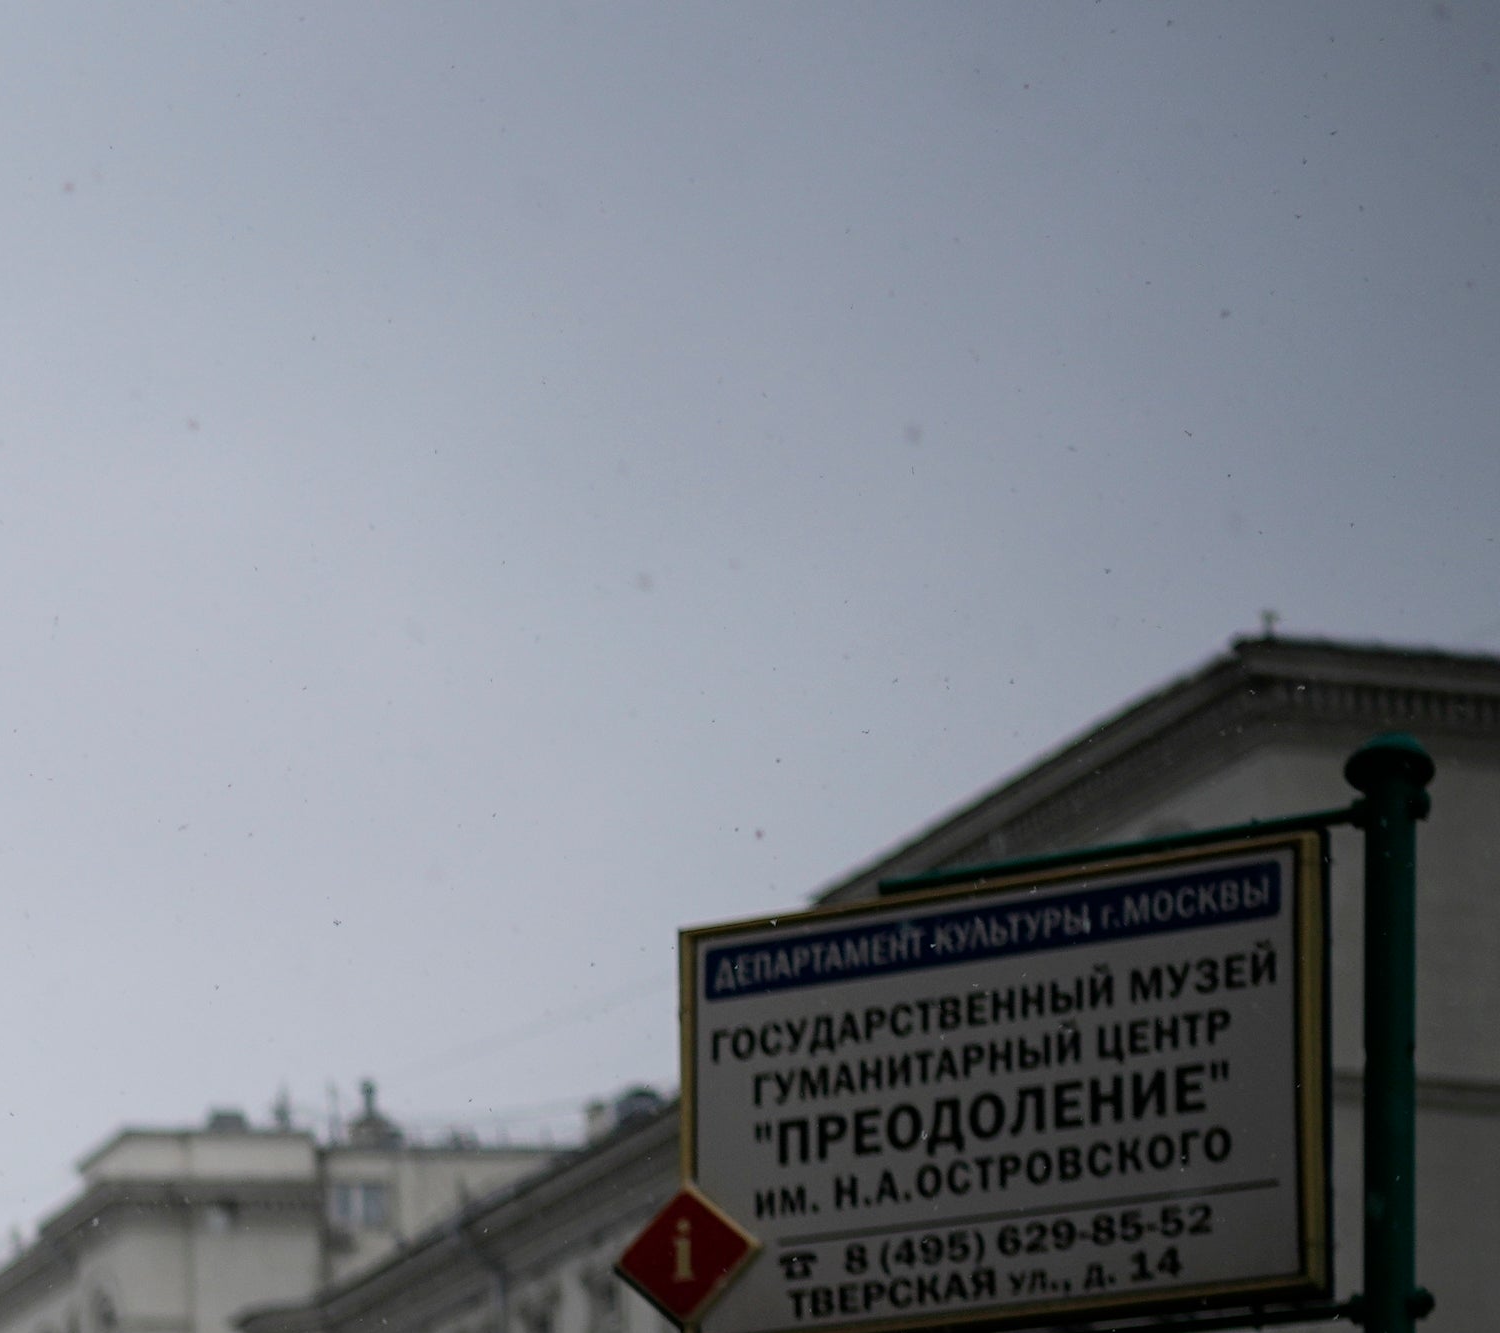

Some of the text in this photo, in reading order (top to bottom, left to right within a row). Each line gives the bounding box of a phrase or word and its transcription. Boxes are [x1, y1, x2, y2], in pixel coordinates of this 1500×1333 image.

[713, 923, 927, 993] ДЕПАРТАМЕНТ
[934, 903, 1091, 955] КУЛЬТУРЫ
[711, 939, 1278, 1064] ГОСУДАРСТВЕННЫЙ МУЗЕЙ
[753, 1007, 1231, 1108] ГУМАНИТАРНЫЙ ЦЕНТР
[754, 1059, 1231, 1168] "ПРЕОДОЛЕНИЕ"
[785, 1267, 996, 1320] ТВЕРСКАЯ
[1130, 1246, 1183, 1282] 14
[844, 1202, 1213, 1276] 8 (495) 629-85-52
